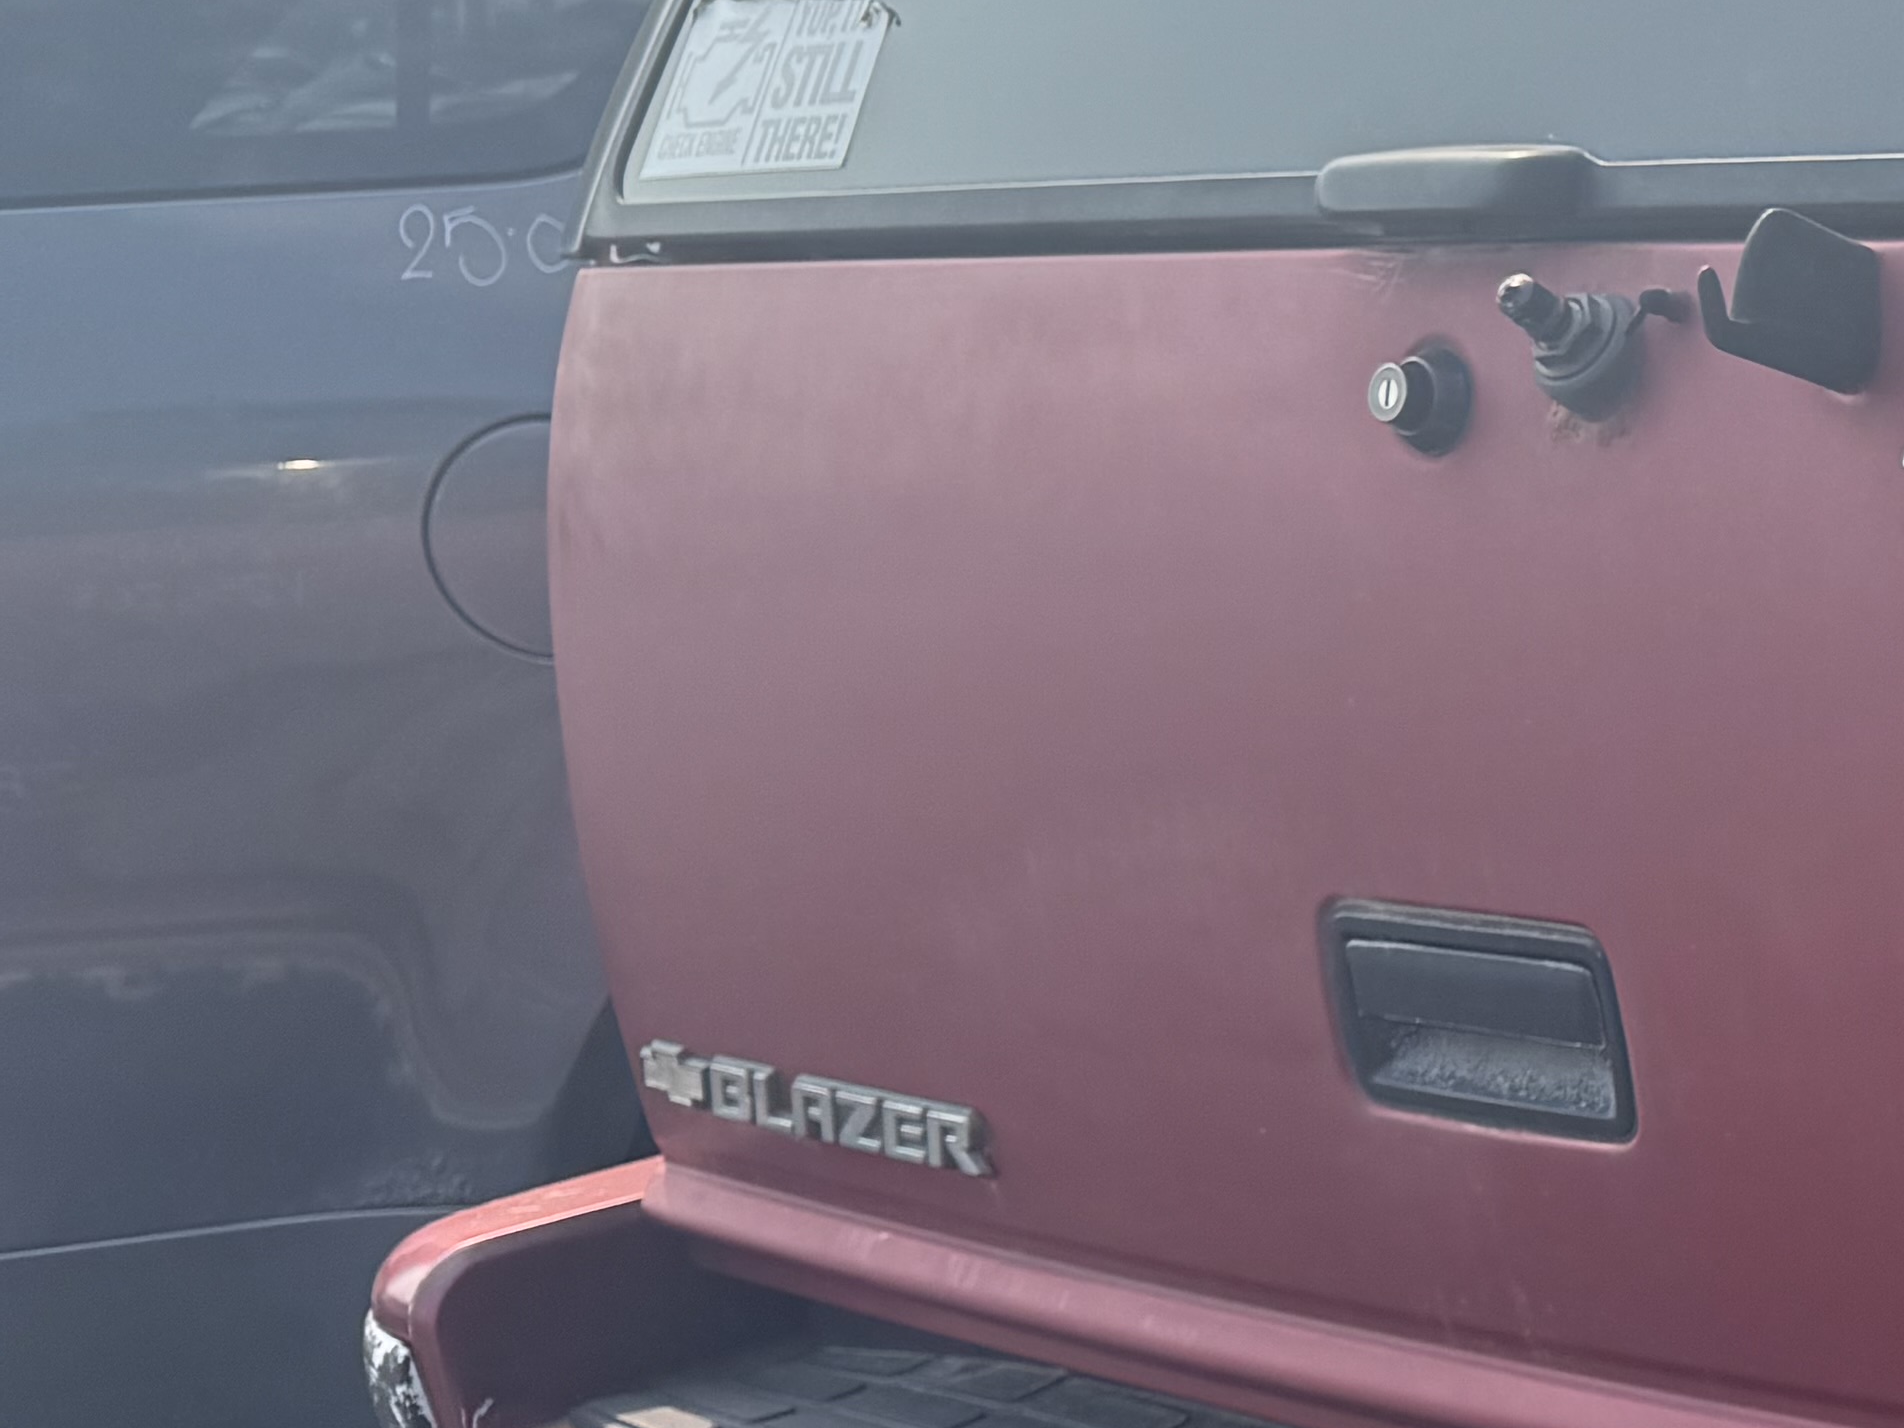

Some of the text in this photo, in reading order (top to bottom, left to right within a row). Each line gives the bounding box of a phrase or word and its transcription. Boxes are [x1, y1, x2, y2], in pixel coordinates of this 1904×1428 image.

[769, 39, 865, 109] STILL
[753, 113, 849, 164] THERE!
[709, 1054, 994, 1177] BLAZER
